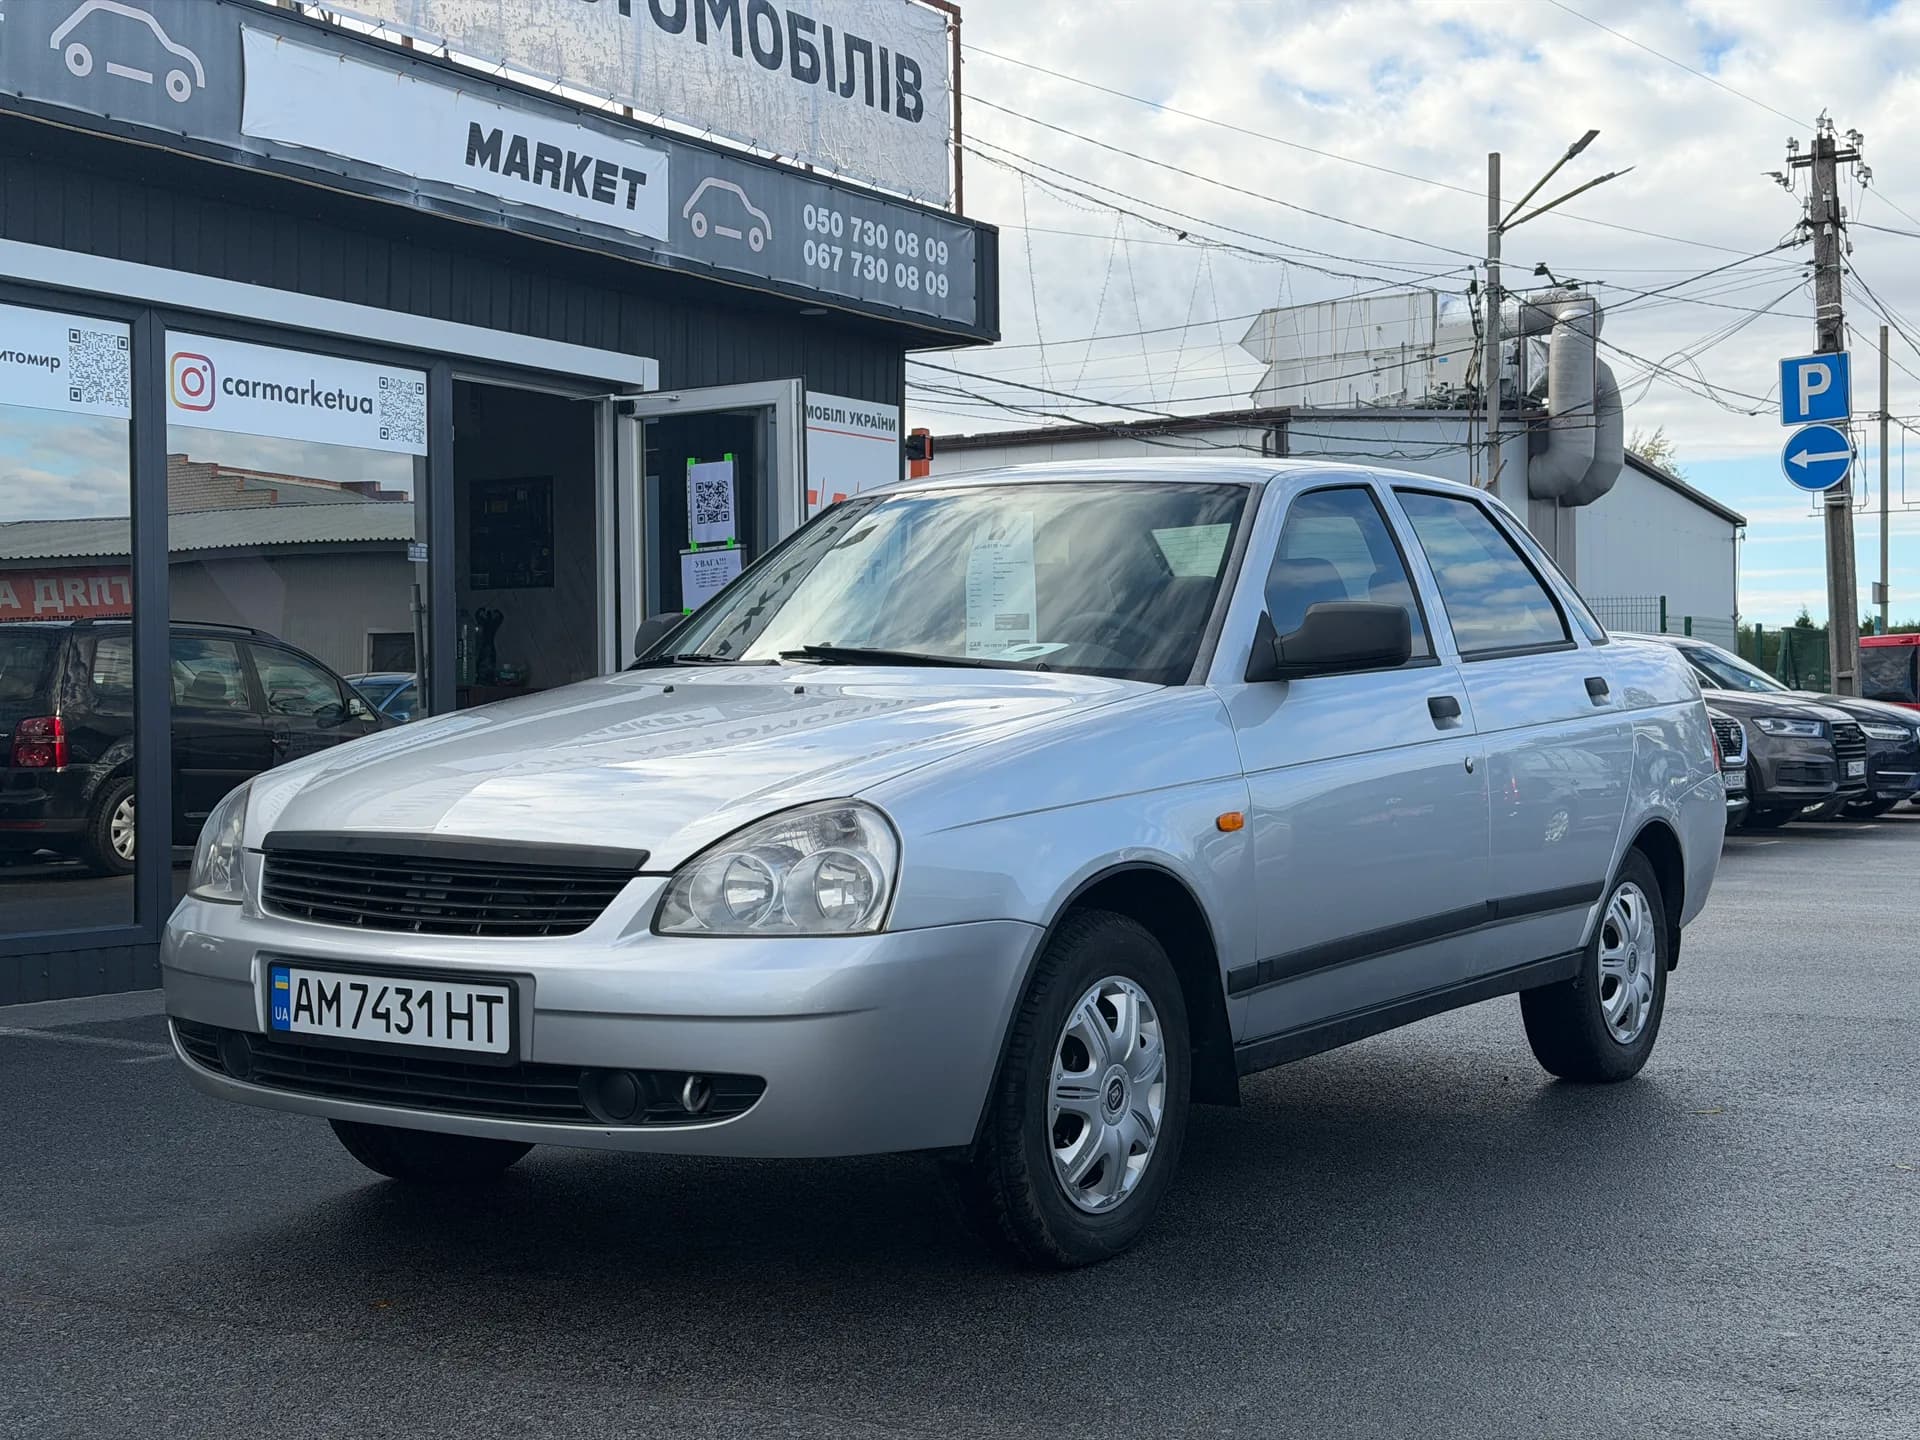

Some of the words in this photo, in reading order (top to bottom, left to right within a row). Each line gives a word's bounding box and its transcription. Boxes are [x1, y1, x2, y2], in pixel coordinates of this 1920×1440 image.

[582, 0, 924, 123] МОБІЛІВ
[465, 121, 647, 211] MARKET
[803, 203, 843, 238] 050
[850, 216, 888, 249] 730
[894, 229, 919, 258] 08
[925, 237, 949, 265] 09
[803, 239, 843, 272] 067
[850, 251, 888, 283] 730
[894, 263, 919, 291] 08
[925, 270, 949, 298] 09
[222, 378, 373, 415] carmarketua
[1798, 363, 1832, 416] P
[849, 411, 896, 432] УКРАЇНИ
[275, 1006, 289, 1022] UA
